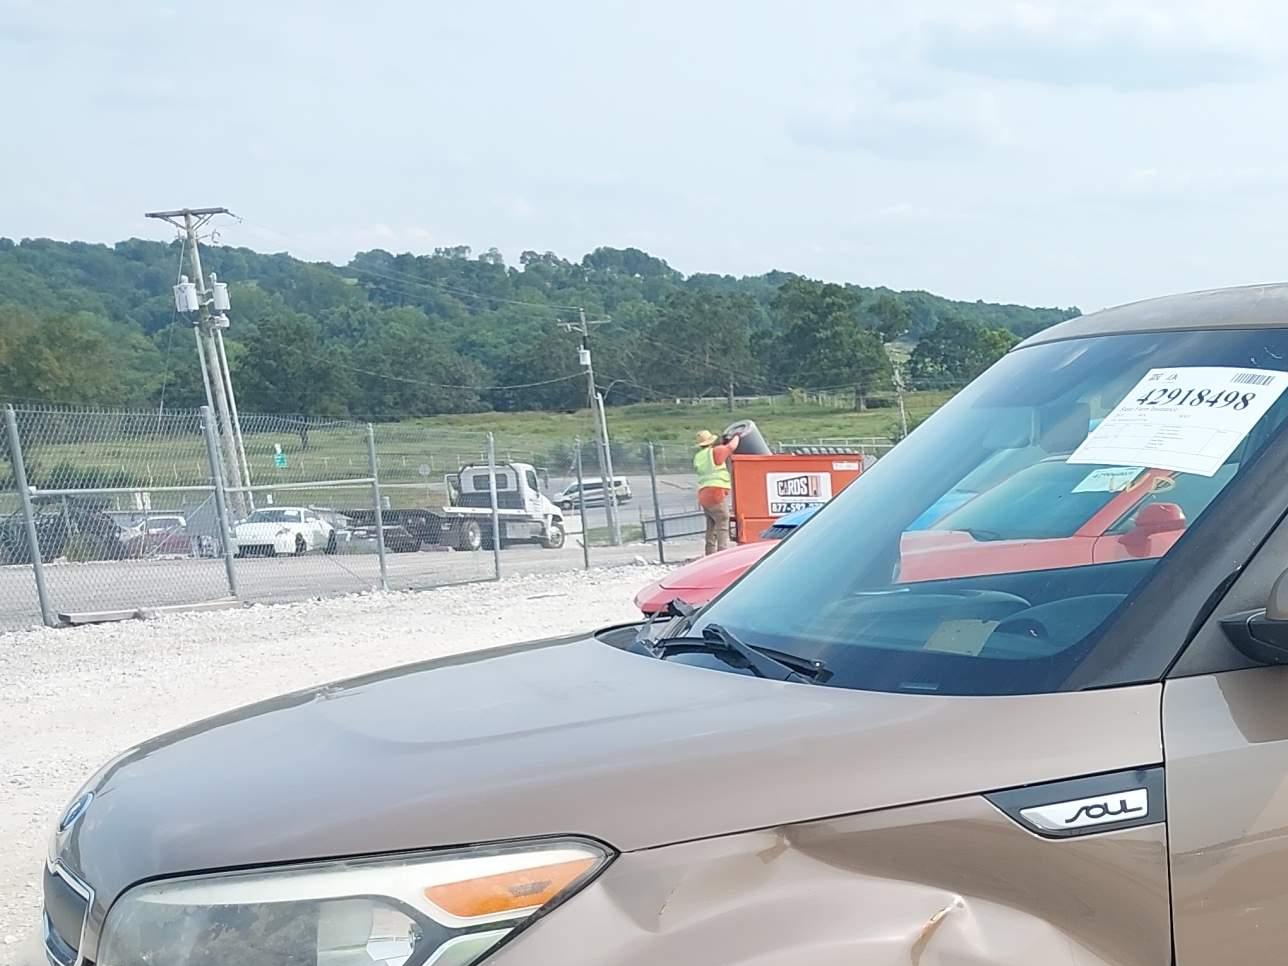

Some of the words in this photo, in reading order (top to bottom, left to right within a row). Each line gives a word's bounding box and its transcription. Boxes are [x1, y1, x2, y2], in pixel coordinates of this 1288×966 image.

[1136, 388, 1256, 411] 42918498
[778, 476, 808, 496] CARDS
[1064, 799, 1143, 823] SOUL
